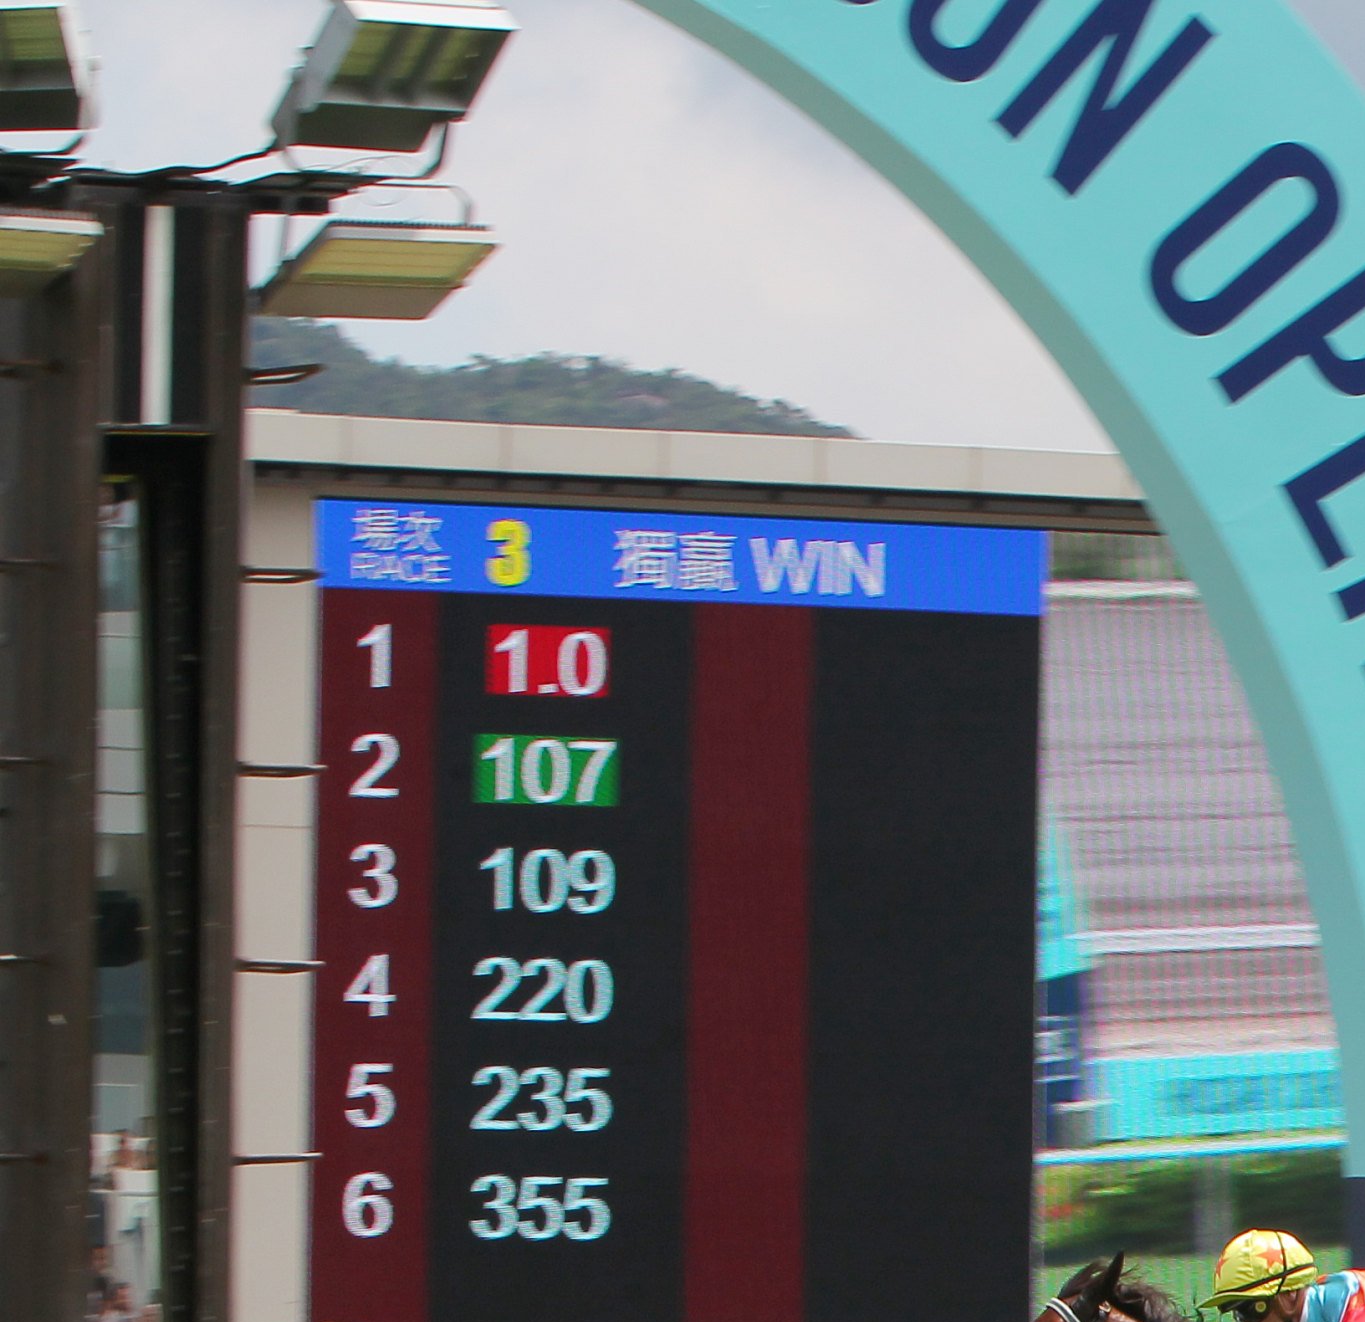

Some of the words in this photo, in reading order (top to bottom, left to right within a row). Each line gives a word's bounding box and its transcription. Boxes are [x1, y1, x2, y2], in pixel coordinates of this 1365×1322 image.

[350, 552, 453, 585] RACE
[486, 519, 531, 587] 3
[749, 536, 888, 597] WIN
[356, 623, 392, 688] 1
[493, 629, 608, 696] 1.0
[347, 732, 401, 799] 2
[481, 737, 618, 804] 107
[346, 842, 399, 909] 3
[479, 847, 616, 914] 109
[342, 953, 398, 1017] 4
[469, 956, 615, 1024] 220
[343, 1062, 397, 1129] 5
[468, 1065, 614, 1132] 235
[341, 1171, 395, 1238] 6
[467, 1174, 612, 1241] 355
